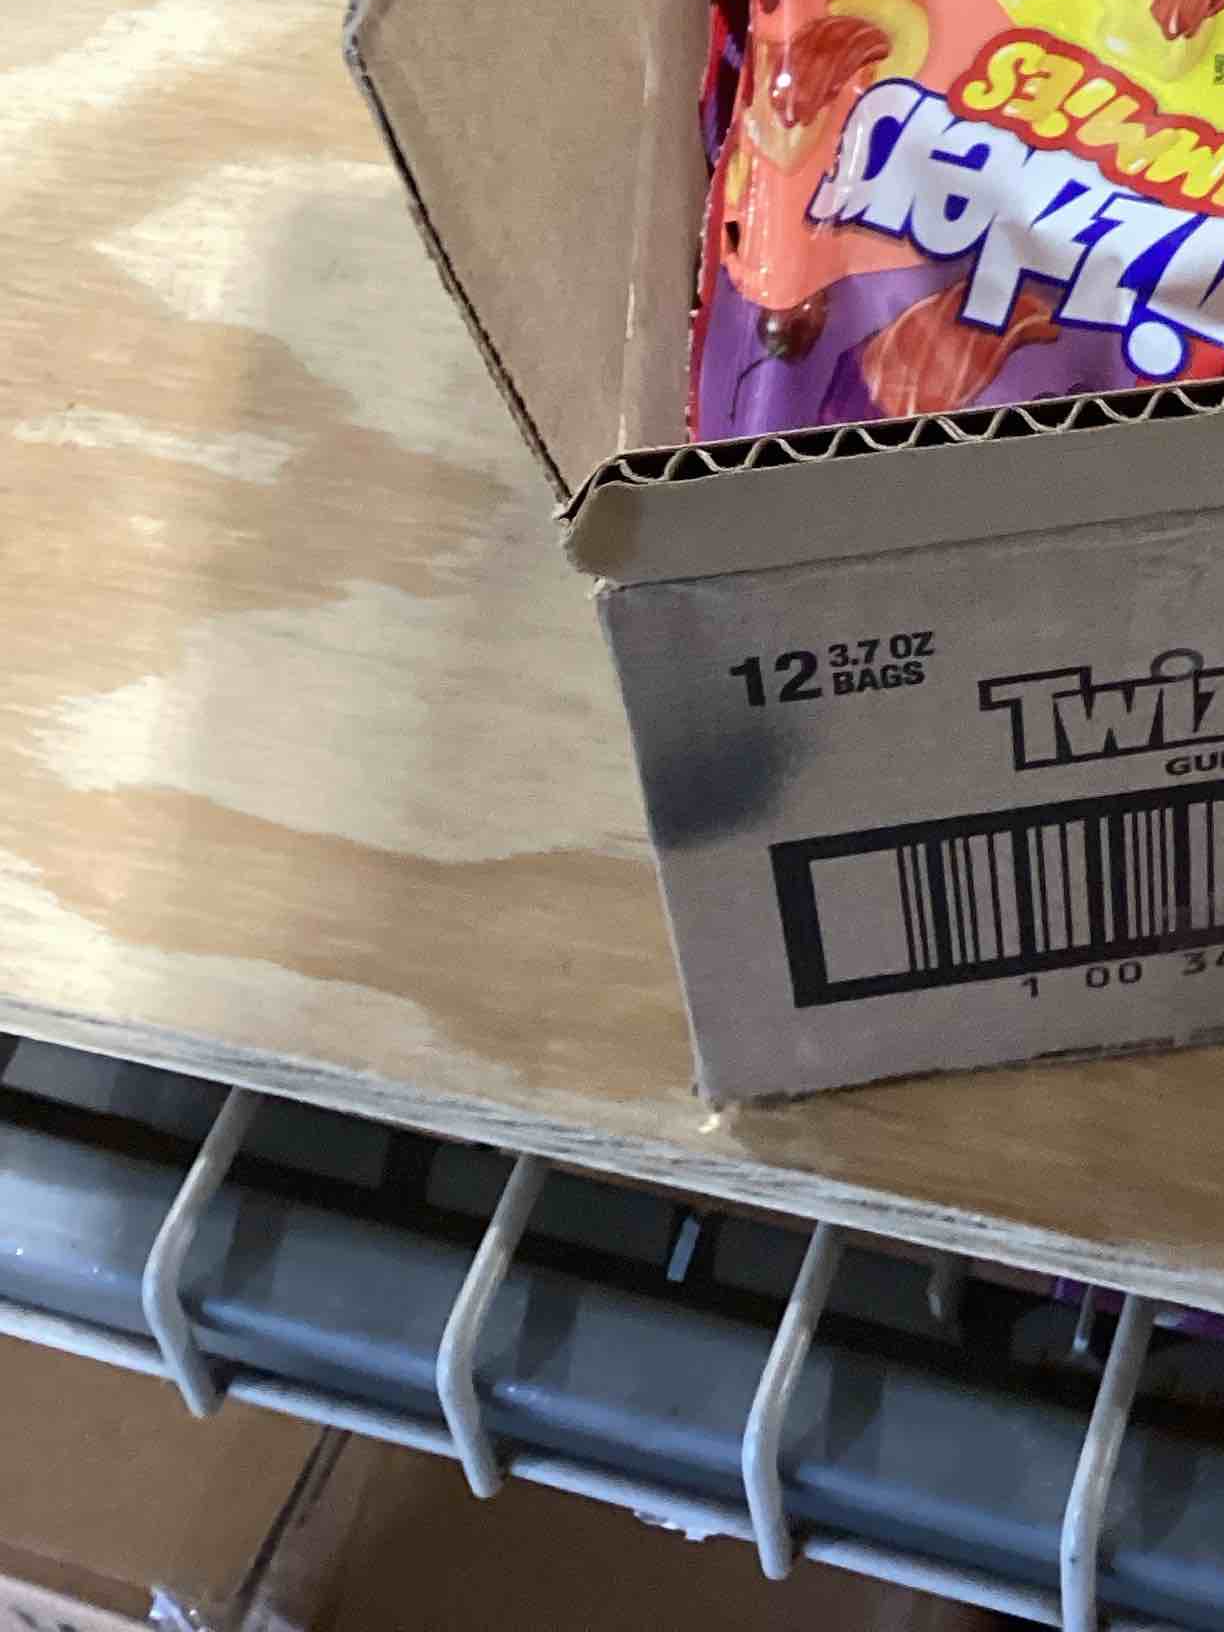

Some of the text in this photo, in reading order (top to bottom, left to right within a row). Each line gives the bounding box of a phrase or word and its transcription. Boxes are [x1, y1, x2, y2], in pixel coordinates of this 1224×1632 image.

[730, 631, 936, 708] 12 3.7 OZ
[832, 660, 926, 697] BAGS
[1021, 976, 1039, 999] 1
[1085, 962, 1144, 989] 00
